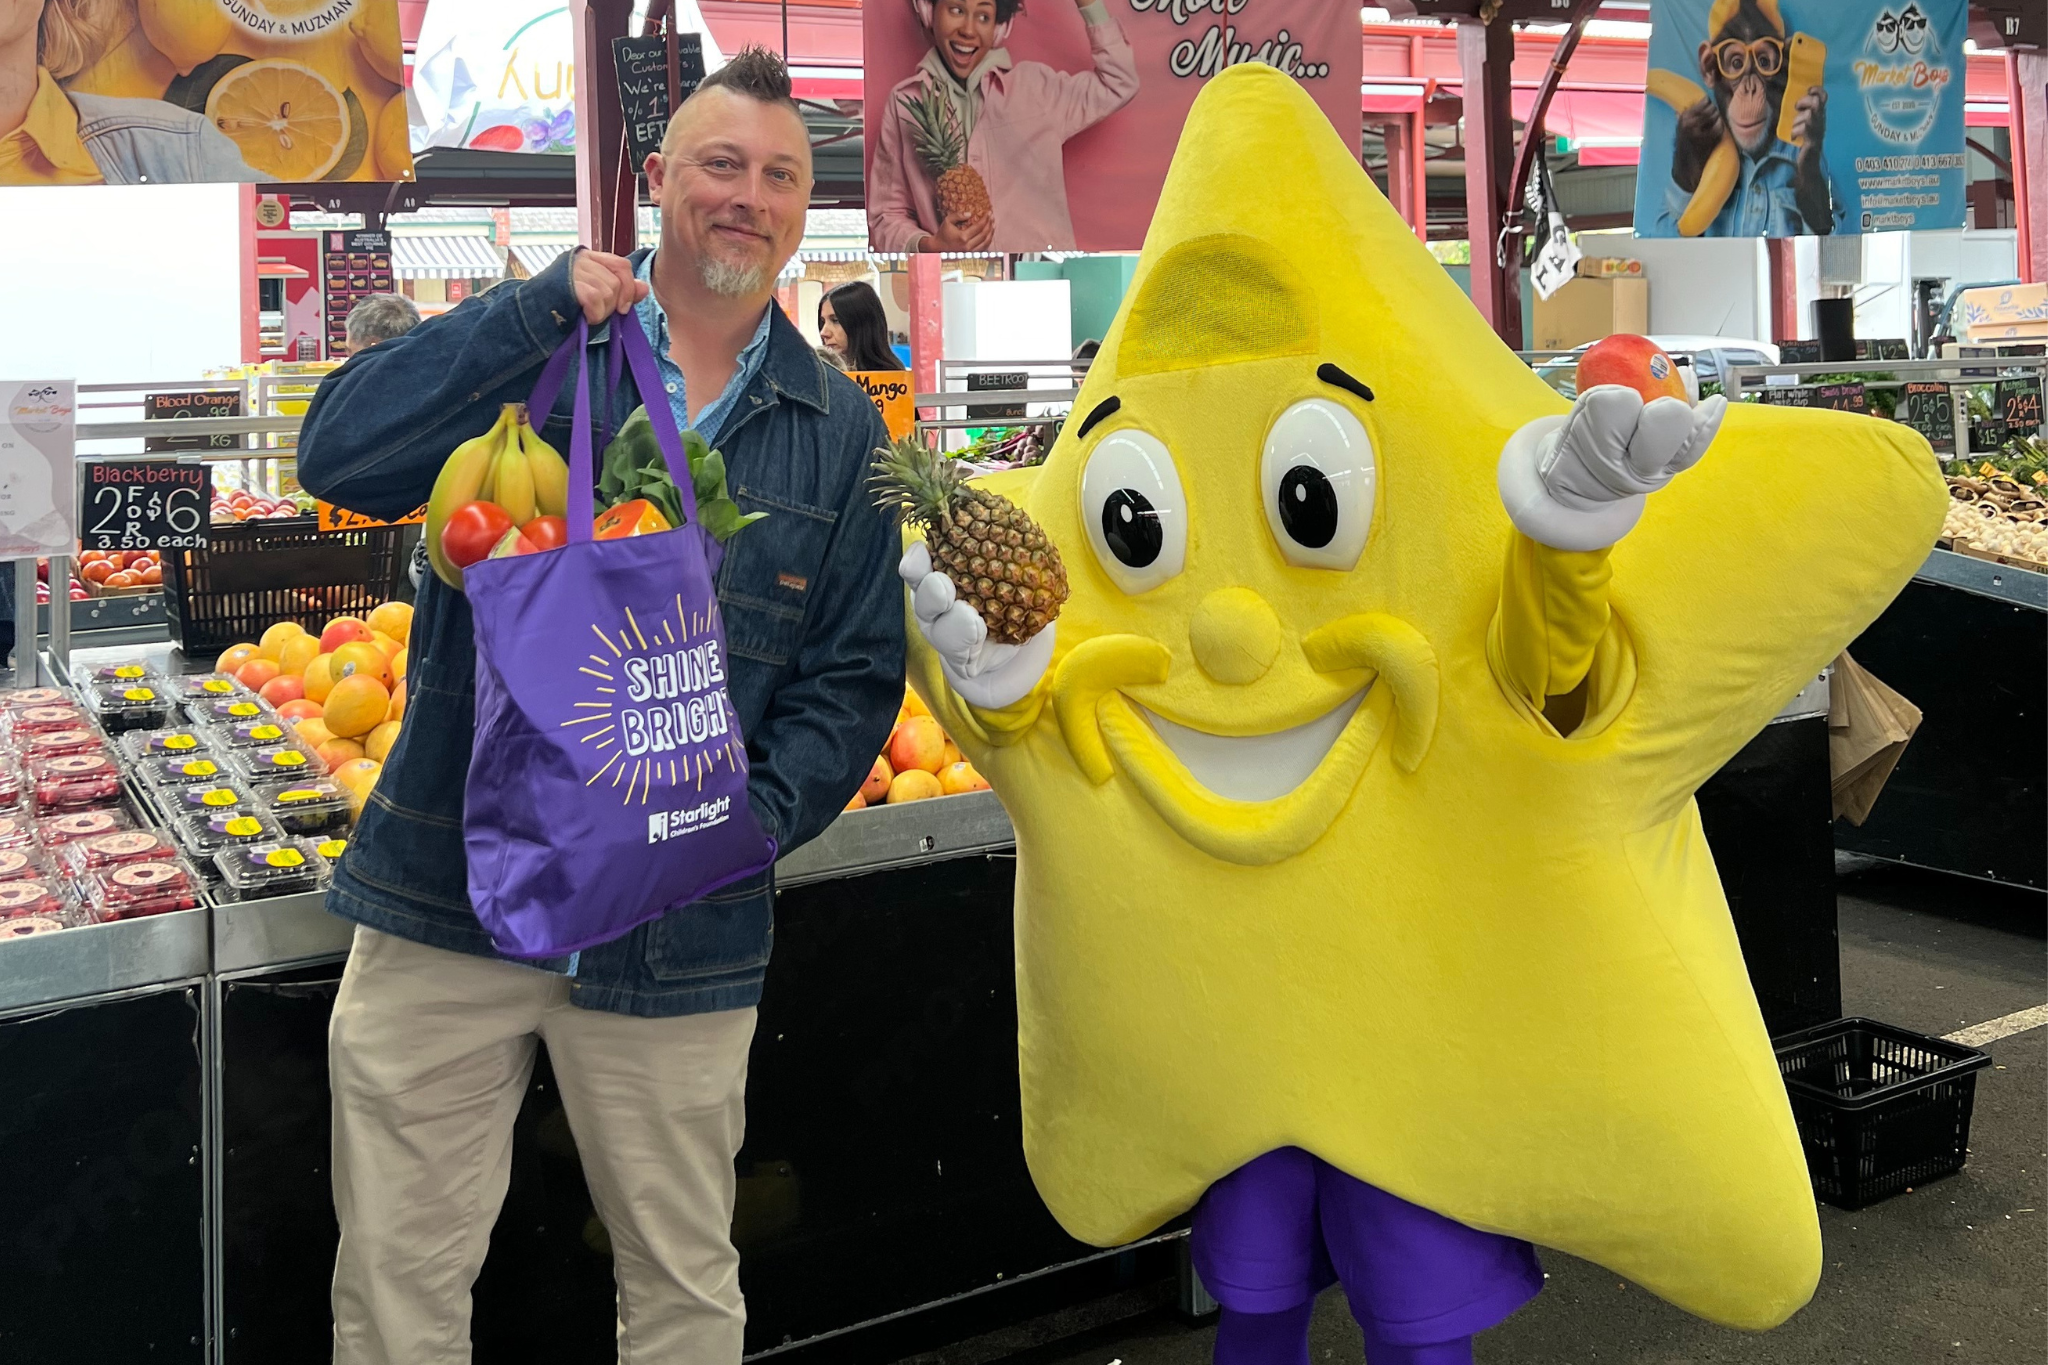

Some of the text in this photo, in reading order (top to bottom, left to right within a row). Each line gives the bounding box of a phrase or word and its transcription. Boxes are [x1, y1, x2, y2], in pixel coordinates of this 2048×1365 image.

[279, 24, 287, 34] &
[291, 0, 352, 35] MUZMAN
[2006, 17, 2020, 36] B7
[1855, 61, 1911, 87] Market
[627, 100, 643, 121] %
[1907, 382, 1948, 394] Broccolini
[156, 394, 240, 409] Blood Orange
[1909, 395, 1930, 425] 2
[209, 434, 232, 447] KG
[93, 465, 204, 492] Blackberry
[90, 486, 122, 534] 2
[146, 488, 201, 533] $6
[97, 533, 208, 550] 3.50 each
[624, 640, 725, 702] SHINE
[670, 795, 731, 828] Starlight
[669, 824, 699, 838] Children's
